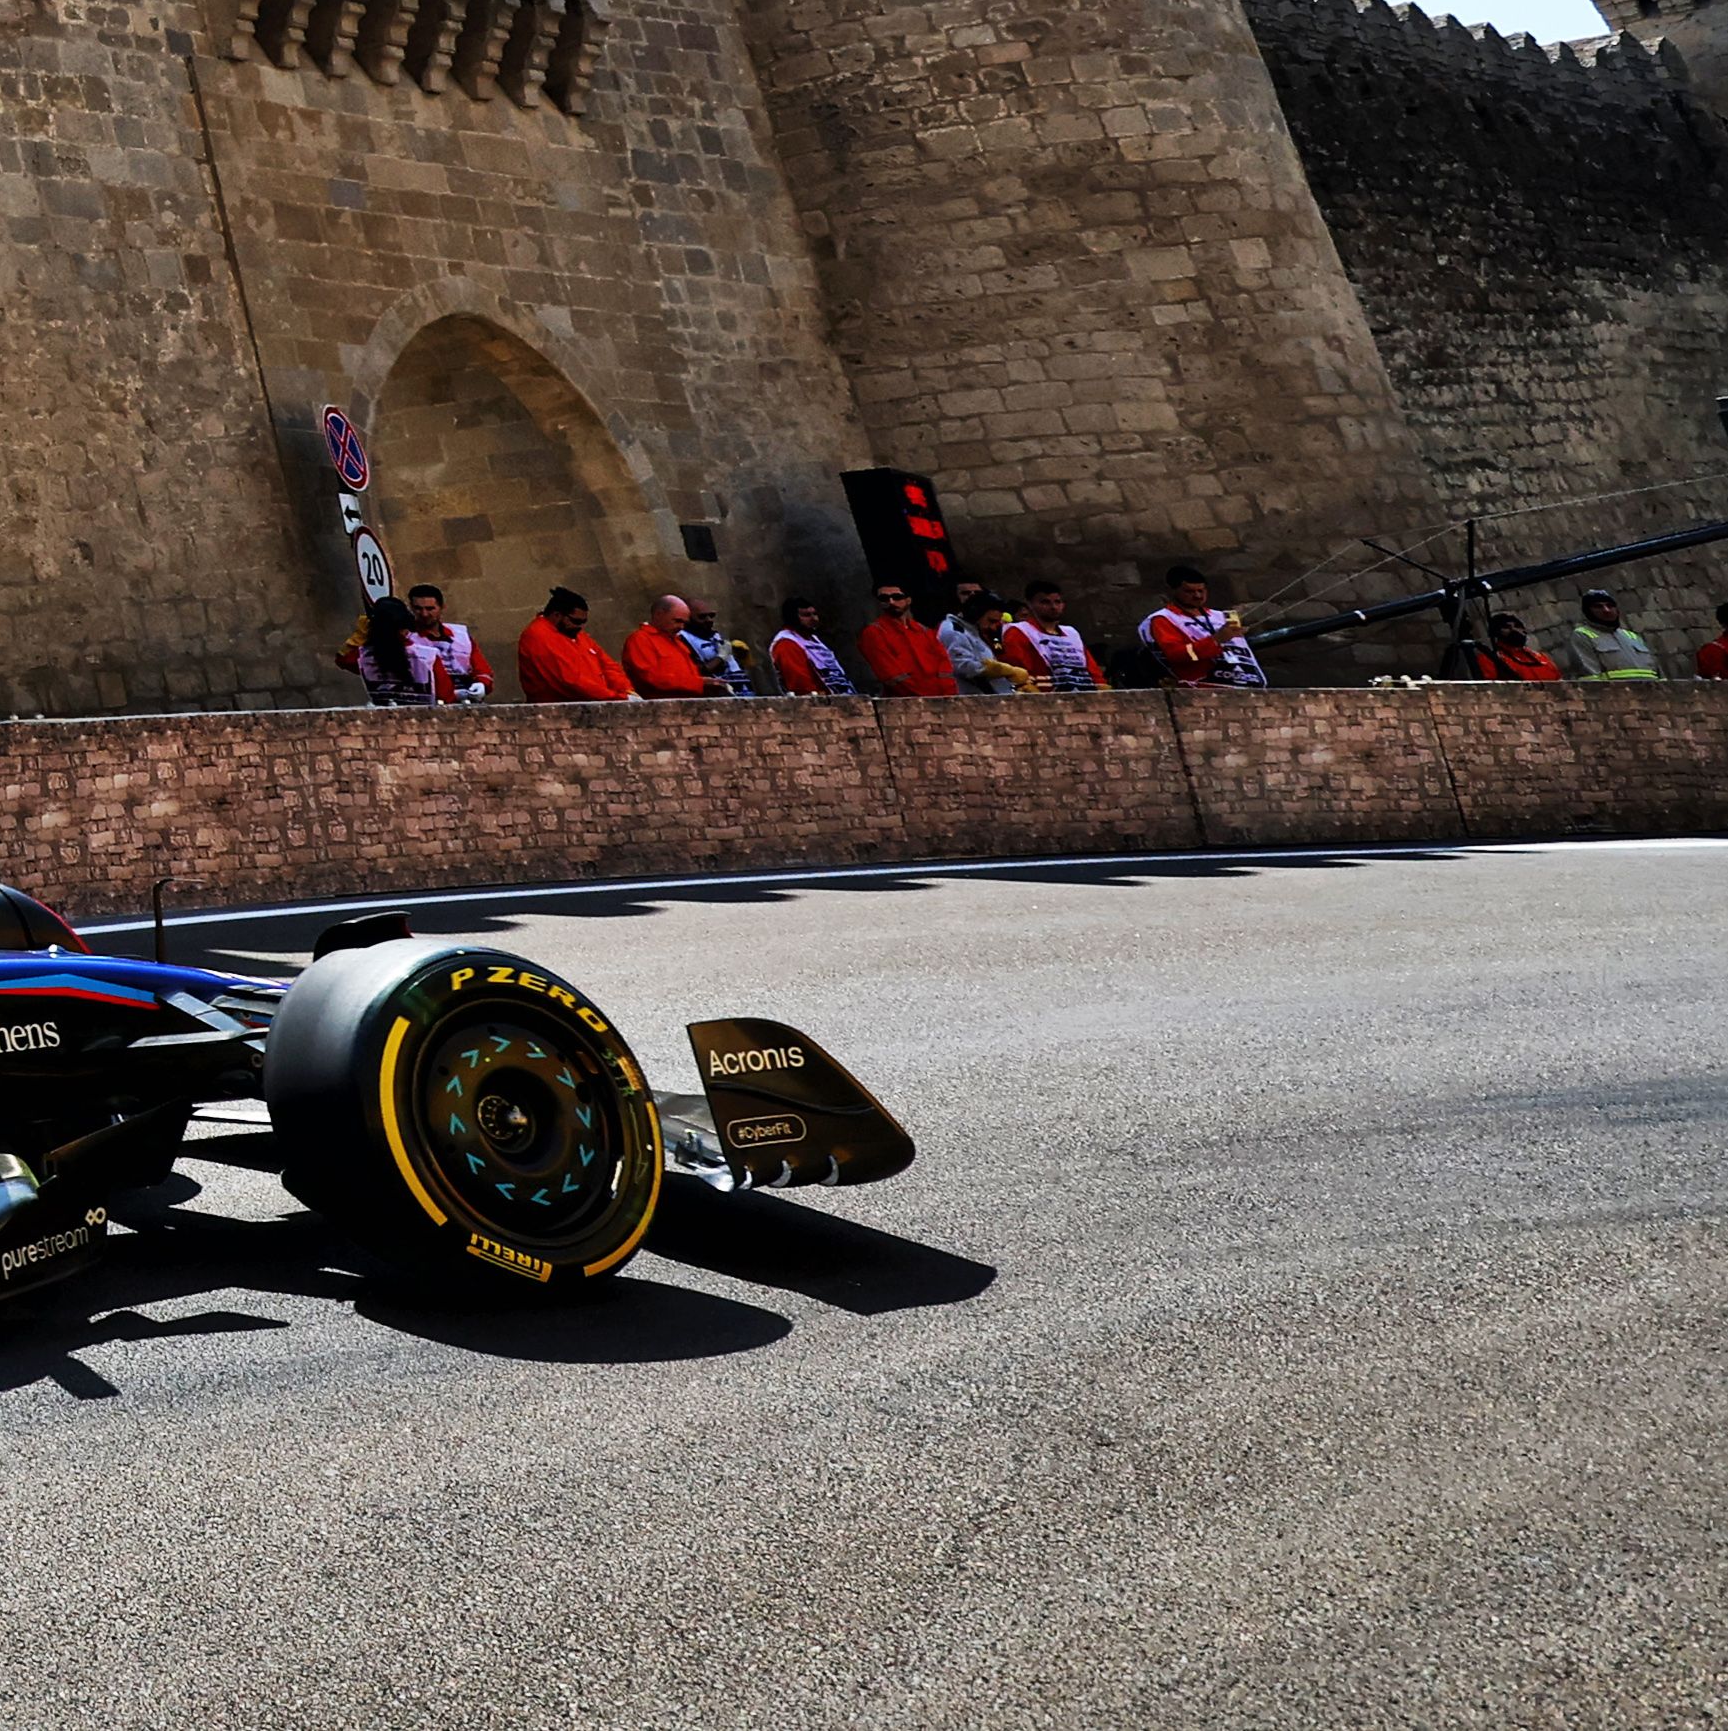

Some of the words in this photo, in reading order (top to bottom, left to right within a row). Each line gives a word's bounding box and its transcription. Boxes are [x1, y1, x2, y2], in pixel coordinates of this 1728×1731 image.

[361, 551, 384, 587] 20
[450, 967, 475, 991] P
[486, 966, 609, 1033] ZERO
[709, 1046, 805, 1077] Acronis
[738, 1122, 793, 1141] #CyberFit
[2, 1226, 90, 1280] purestream
[466, 1232, 553, 1283] PIRELLI
